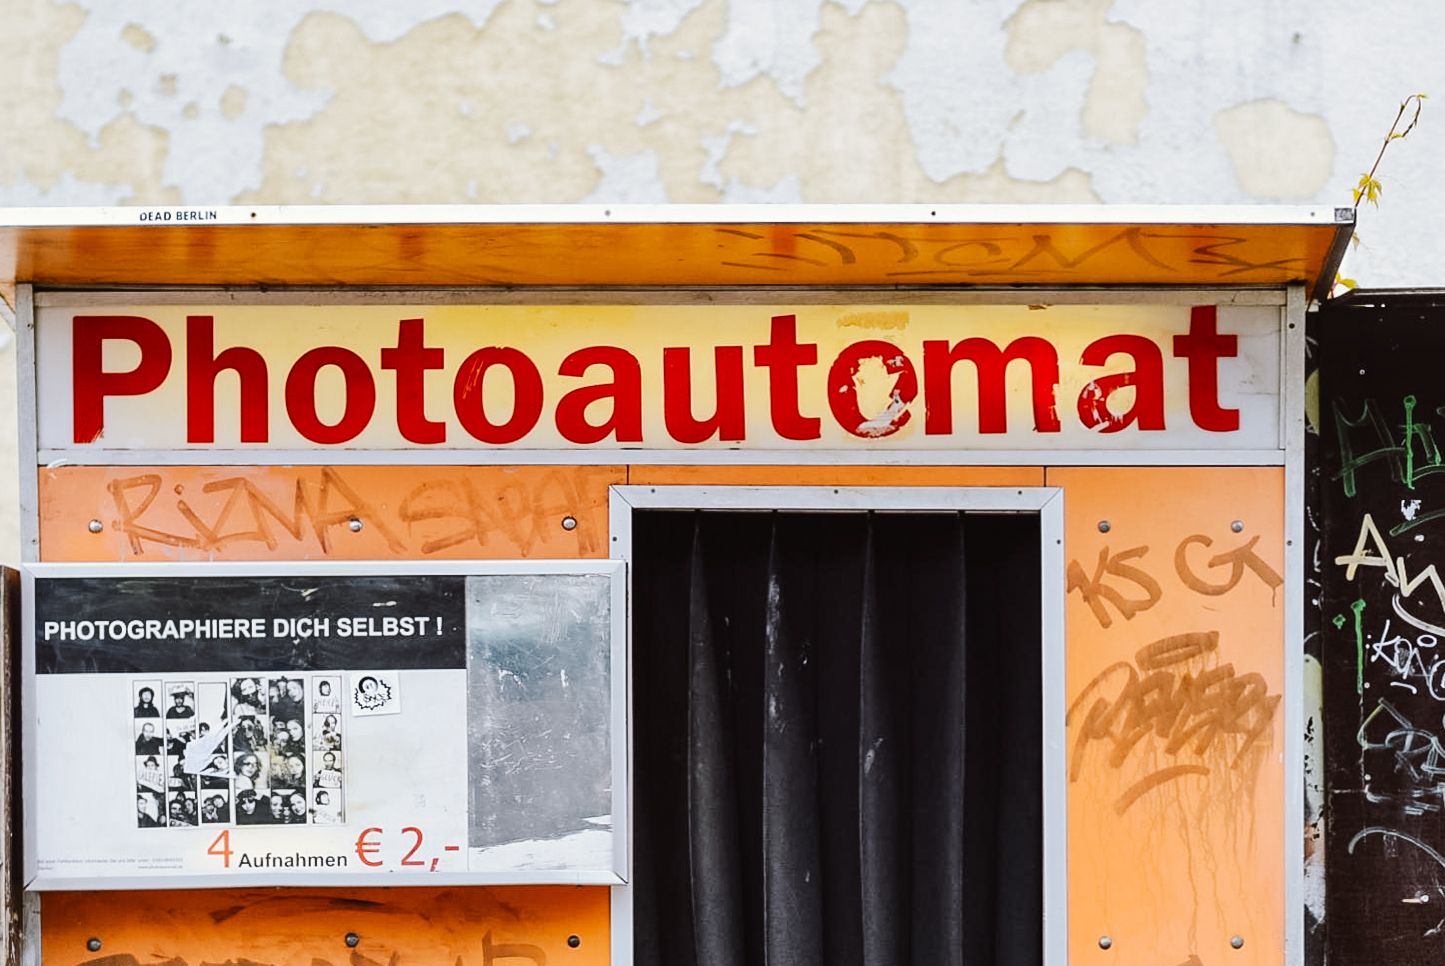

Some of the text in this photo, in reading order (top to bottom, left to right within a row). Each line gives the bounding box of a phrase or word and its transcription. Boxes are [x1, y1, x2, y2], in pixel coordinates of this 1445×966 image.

[139, 210, 217, 221] DEAD BERLIN
[72, 304, 1241, 446] Photoautomat
[43, 618, 267, 641] PHOTOGRAPHIERE
[272, 617, 331, 638] DICH
[336, 616, 430, 637] SELBST
[207, 829, 234, 868] 4
[238, 852, 348, 868] Aufnahmen
[355, 827, 384, 867] €
